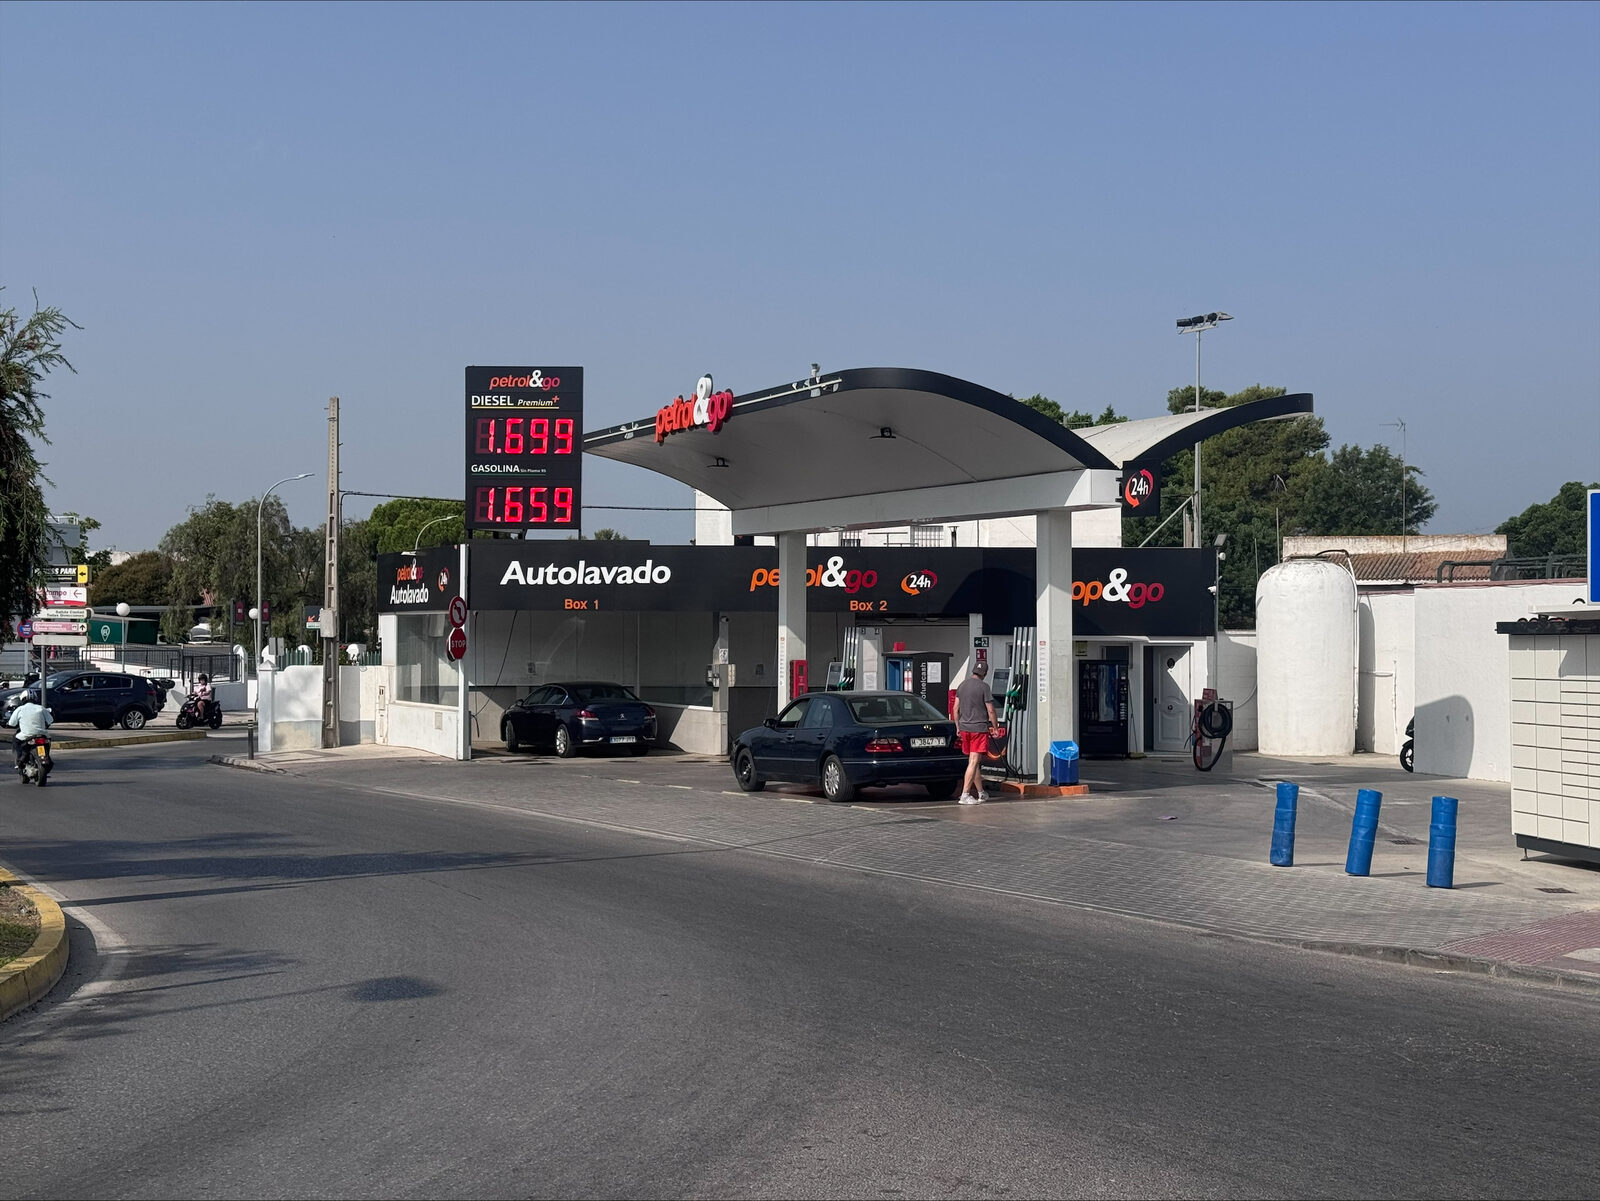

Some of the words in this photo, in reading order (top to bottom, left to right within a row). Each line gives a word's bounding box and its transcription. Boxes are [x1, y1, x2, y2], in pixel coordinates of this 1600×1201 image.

[489, 370, 560, 391] petrol&go
[471, 395, 514, 406] DIESEL
[654, 376, 732, 443] petrol&go
[488, 418, 574, 454] 1.699
[471, 464, 520, 473] GASOLINA
[1130, 477, 1149, 496] 24h
[487, 486, 573, 522] 1.659
[60, 567, 77, 575] PARK
[500, 560, 671, 585] Autolavado
[750, 555, 878, 594] peol&go
[909, 574, 931, 588] 24h
[389, 582, 429, 605] Autolavado
[1071, 567, 1165, 609] op&go
[564, 599, 588, 610] Box
[594, 599, 599, 610] 1
[850, 601, 873, 611] Box
[879, 601, 888, 611] 2
[452, 640, 466, 648] STOP
